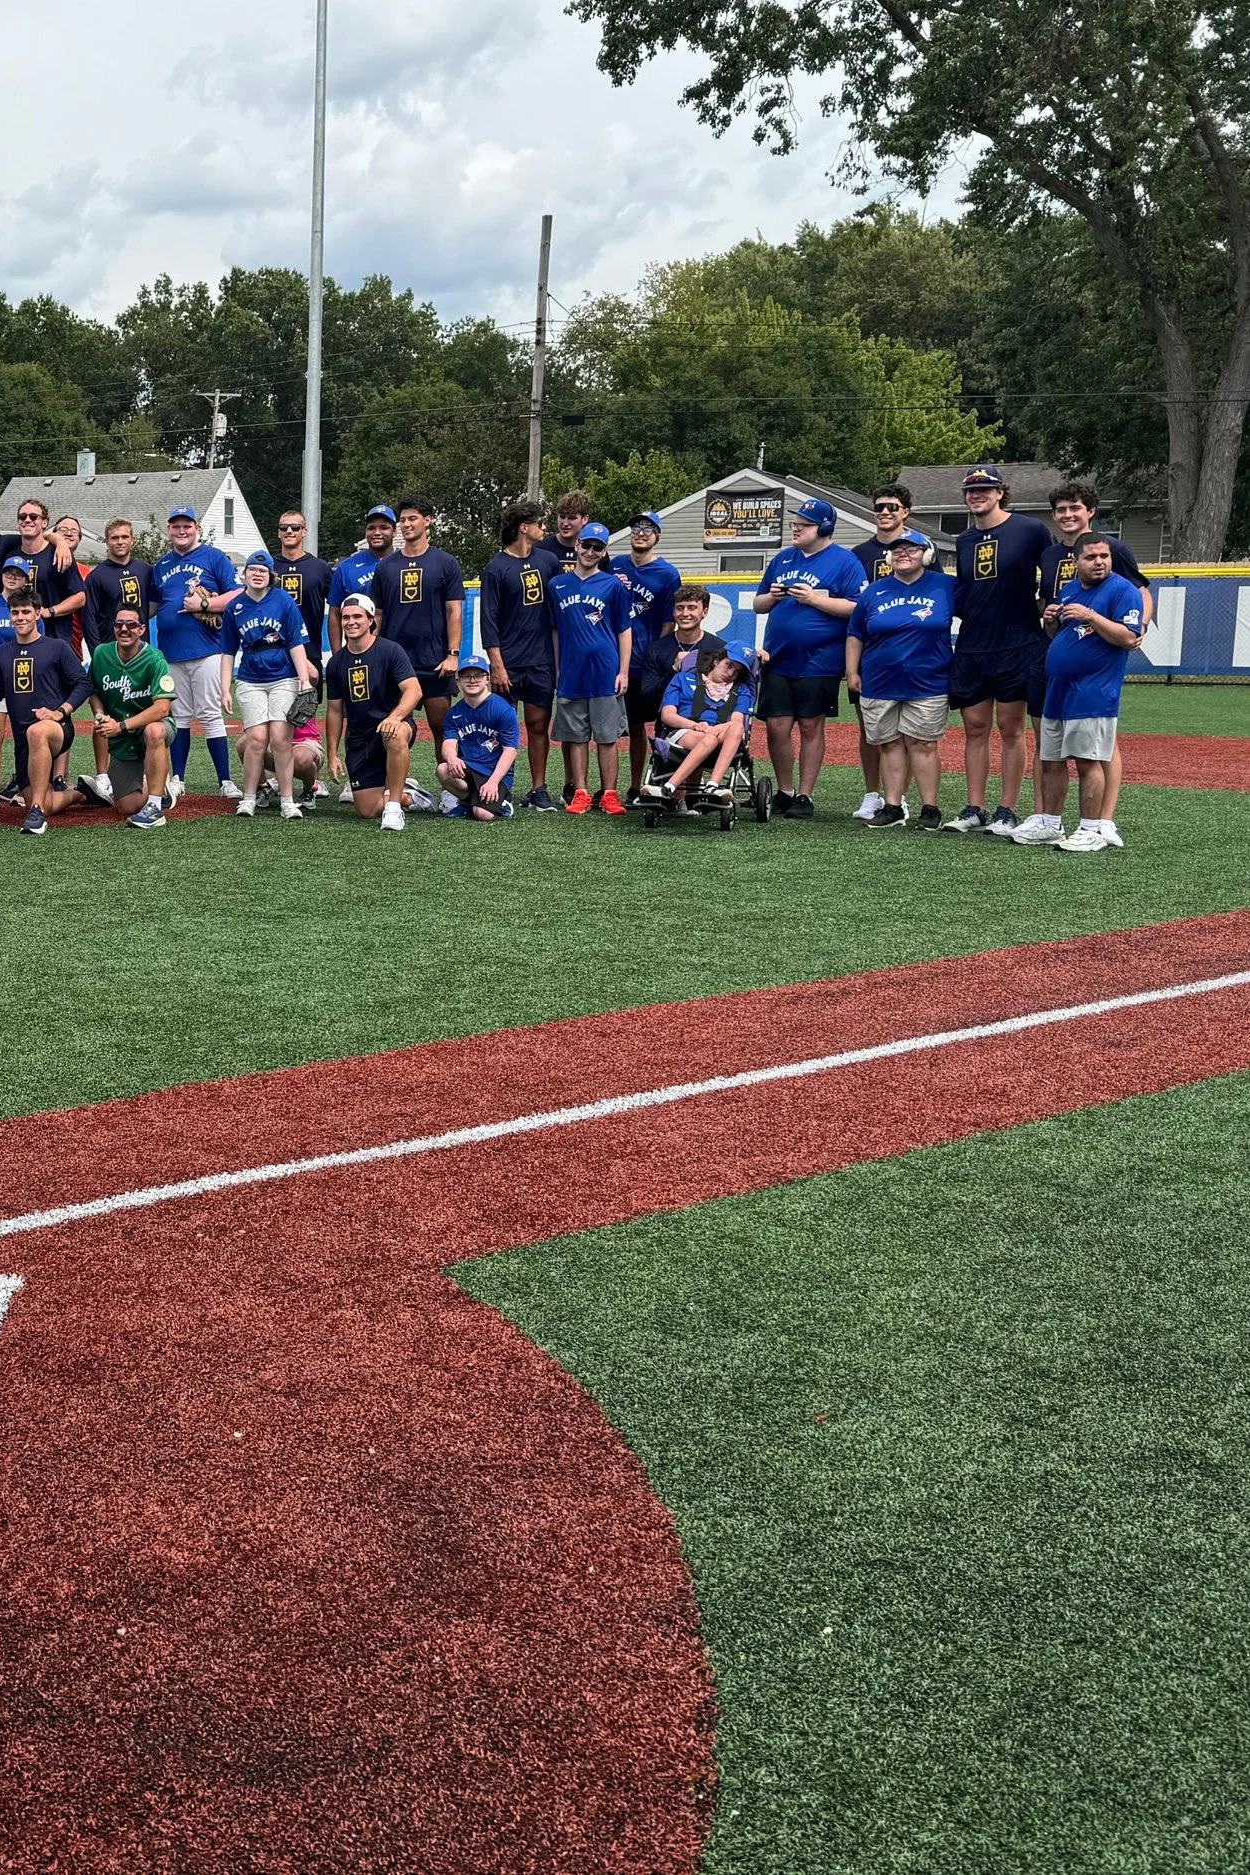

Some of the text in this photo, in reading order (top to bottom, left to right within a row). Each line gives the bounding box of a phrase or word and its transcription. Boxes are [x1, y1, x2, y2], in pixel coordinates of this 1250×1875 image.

[732, 500, 781, 510] WE BUILD SPACES
[733, 508, 777, 518] YOU'LL LOVE.
[161, 563, 204, 583] BLUE JAYS
[777, 570, 821, 588] BLUE JAYS
[633, 583, 655, 602] JAYS
[559, 594, 605, 611] BLUE JAYS
[877, 596, 935, 613] BLUE JAYS
[239, 617, 282, 636] BLUE JAYS
[103, 675, 131, 691] South
[120, 686, 152, 702] Bend
[458, 723, 499, 739] BLUE JAYS
